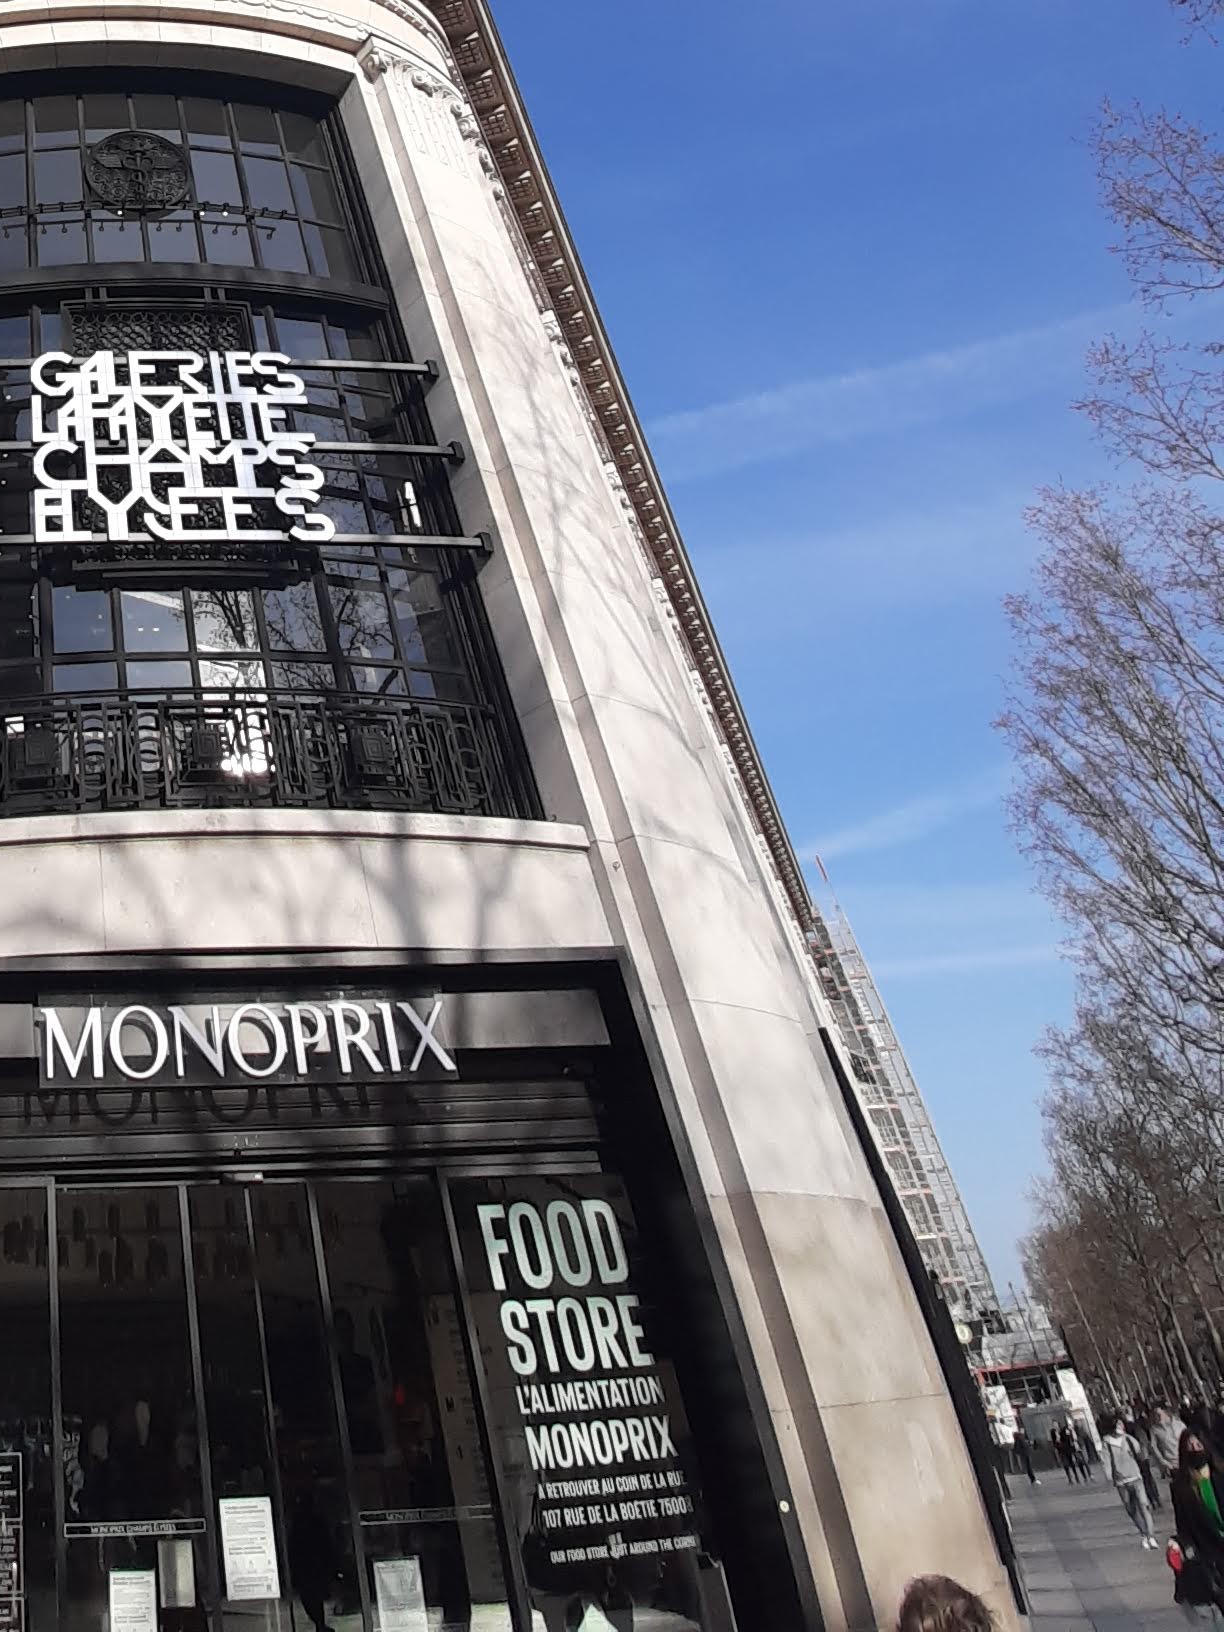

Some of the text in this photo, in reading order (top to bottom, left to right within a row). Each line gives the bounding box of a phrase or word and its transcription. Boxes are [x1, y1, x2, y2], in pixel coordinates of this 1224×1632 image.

[34, 439, 325, 490] CHAMPS
[40, 1001, 457, 1080] MONOPRIX
[476, 1199, 629, 1291] FOOD
[500, 1295, 656, 1376] STORE
[515, 1376, 665, 1416] L'ALIMENTATION
[525, 1415, 679, 1470] MONOPRIX
[546, 1479, 600, 1499] RETROUVER
[601, 1477, 615, 1496] AU
[616, 1474, 639, 1493] COIN
[639, 1473, 654, 1490] DE
[653, 1471, 669, 1489] LA
[542, 1508, 561, 1529] 107
[564, 1507, 588, 1527] RUE
[587, 1506, 604, 1525] DE
[603, 1503, 619, 1523] LA
